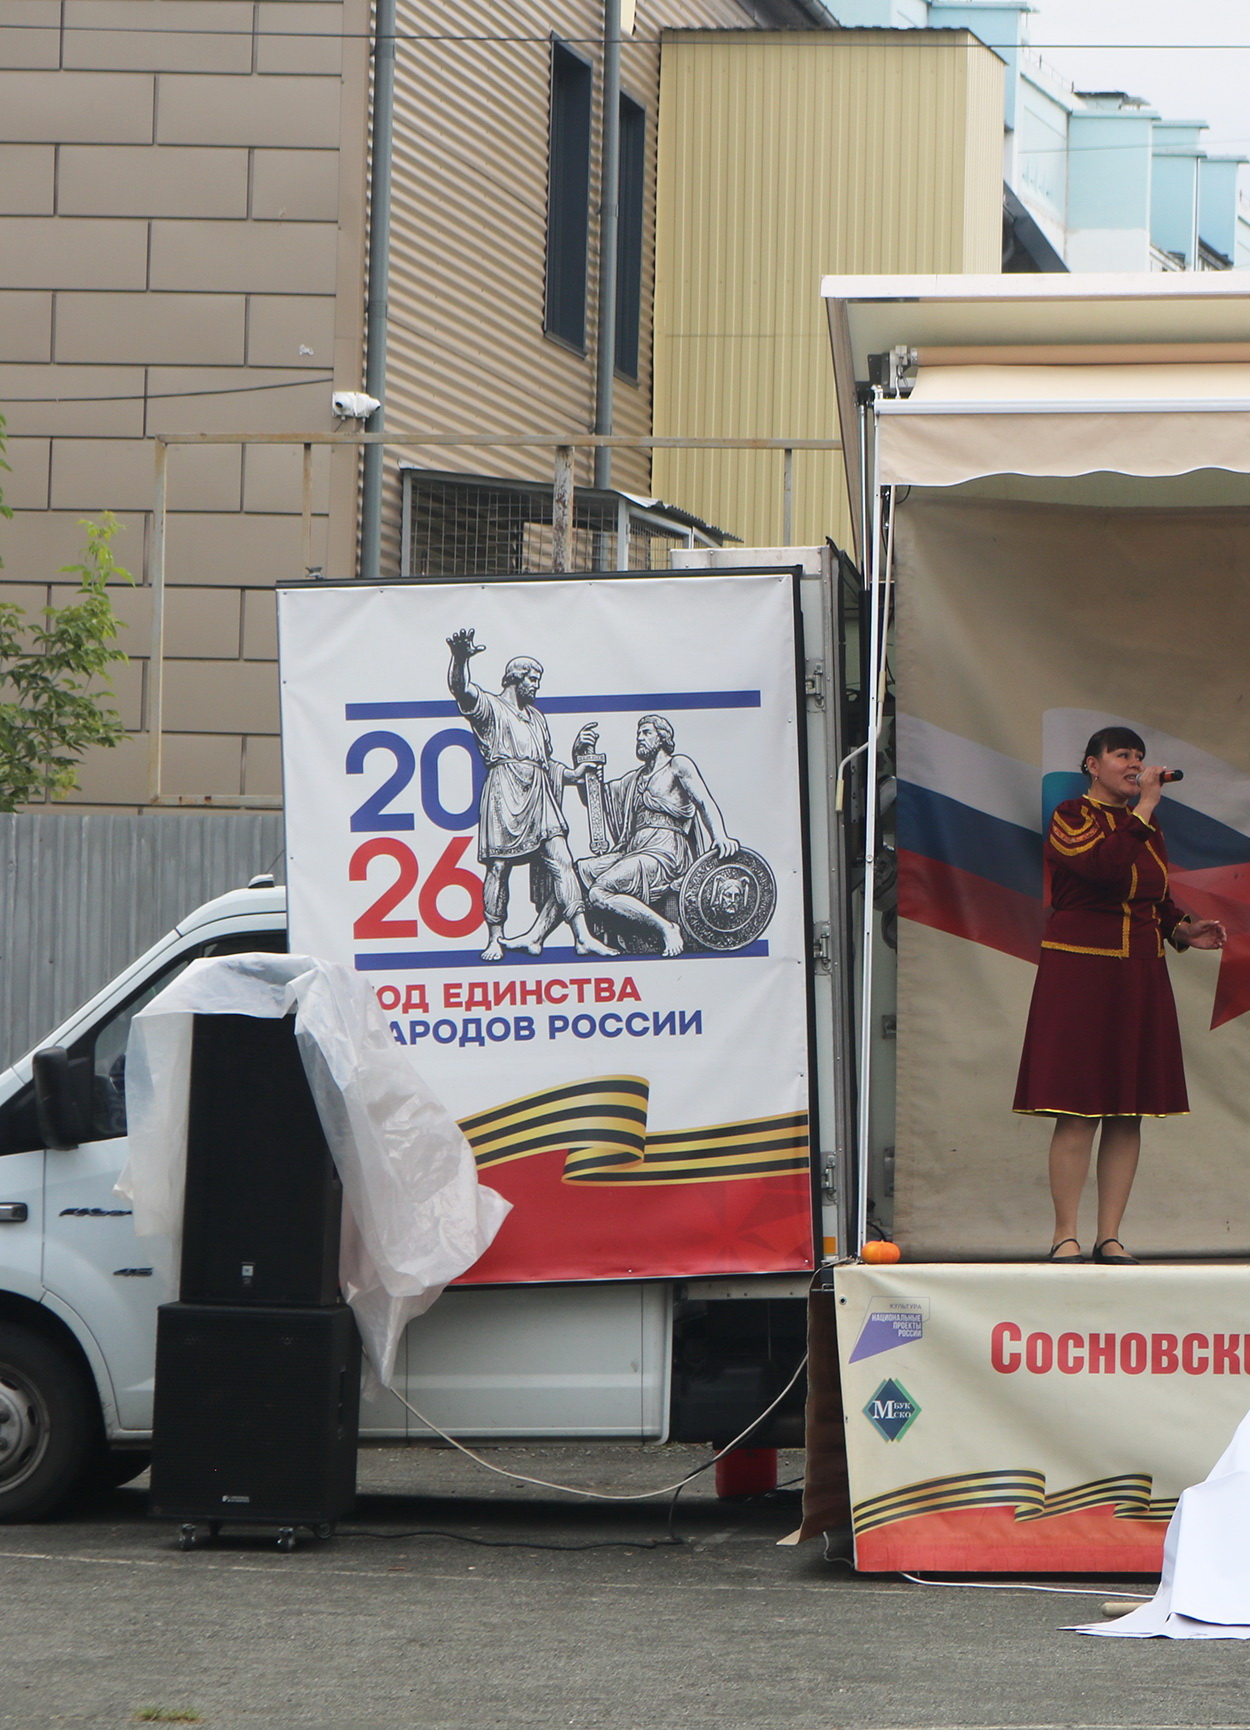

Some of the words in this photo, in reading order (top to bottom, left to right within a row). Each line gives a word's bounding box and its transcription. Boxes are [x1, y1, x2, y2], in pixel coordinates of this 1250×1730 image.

[345, 727, 488, 832] 20
[348, 836, 486, 940] 26
[373, 984, 430, 1015] ОД
[442, 976, 642, 1012] ЕДИНСТВА
[388, 1016, 536, 1048] АРОДОВ
[548, 1009, 703, 1041] РОССИИ
[871, 1313, 922, 1323] НАЦИОНАЛЬНЫЕ
[889, 1303, 922, 1311] КУЛЬТУРА
[892, 1321, 922, 1330] ПРОЕКТЫ
[897, 1329, 922, 1338] РОССИИ
